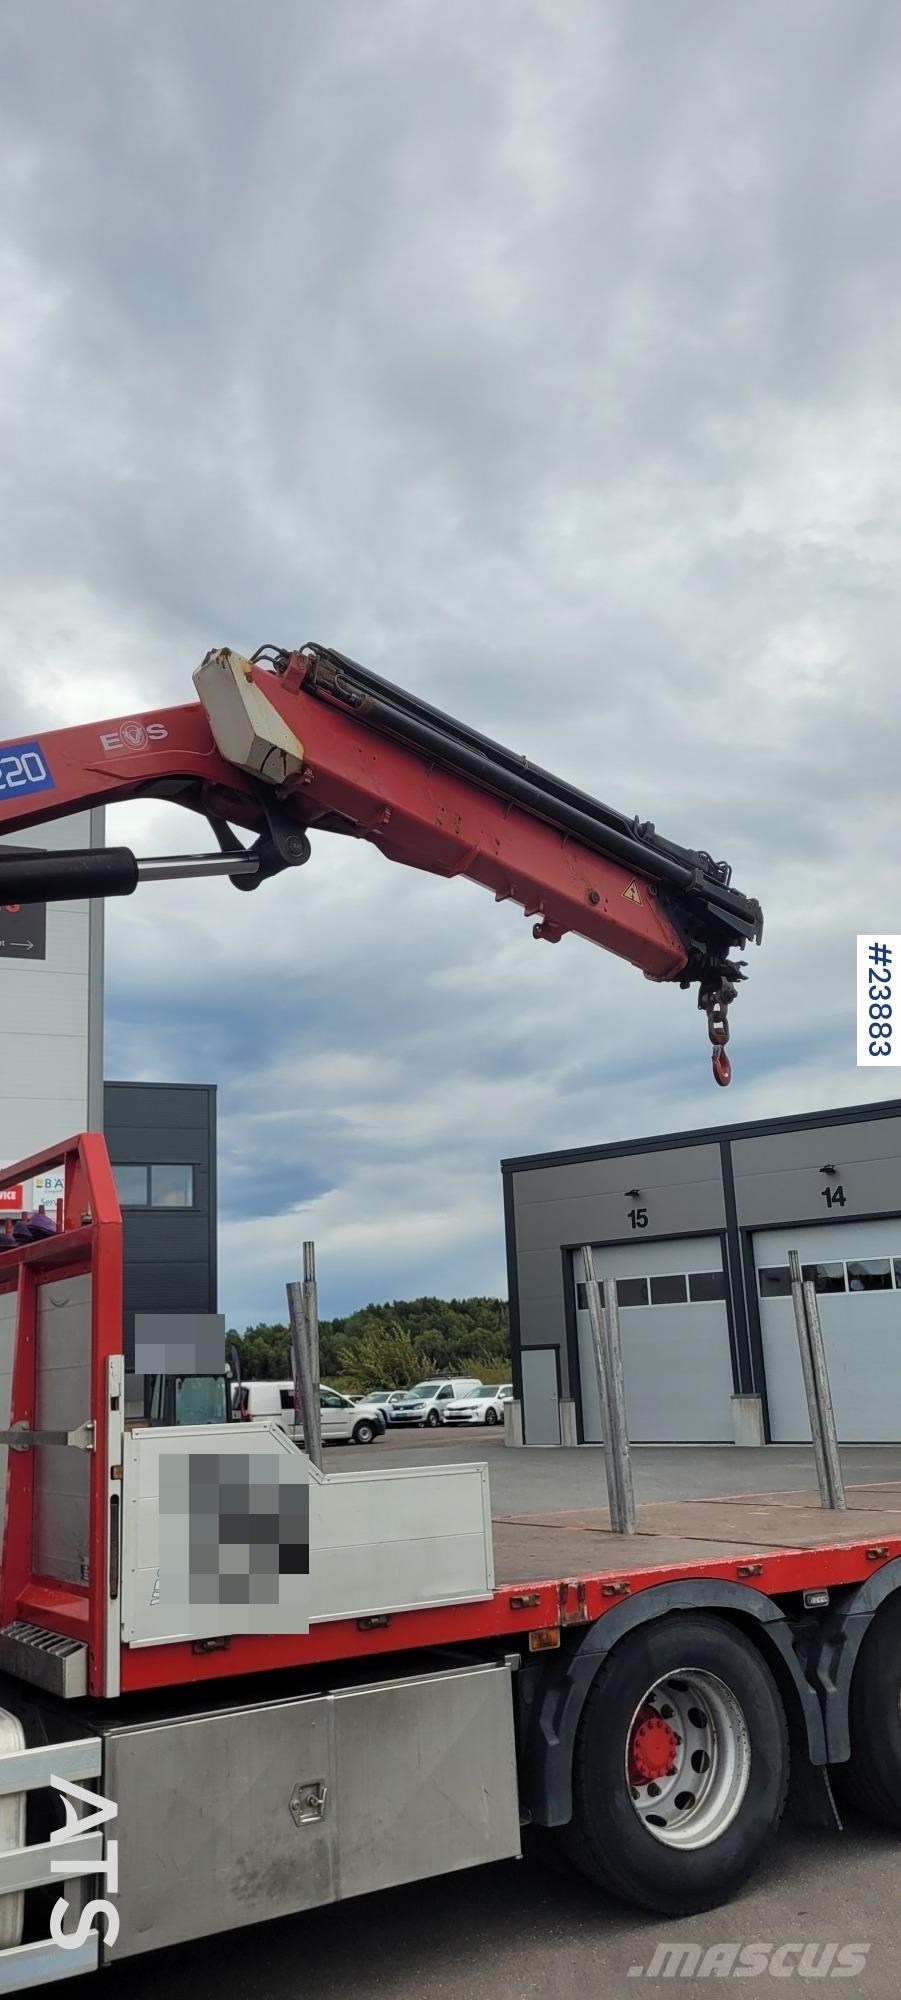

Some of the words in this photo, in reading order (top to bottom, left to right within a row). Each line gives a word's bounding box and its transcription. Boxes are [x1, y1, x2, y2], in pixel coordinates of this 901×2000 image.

[0, 752, 46, 790] 20
[821, 1185, 847, 1208] 14
[627, 1208, 649, 1229] 15
